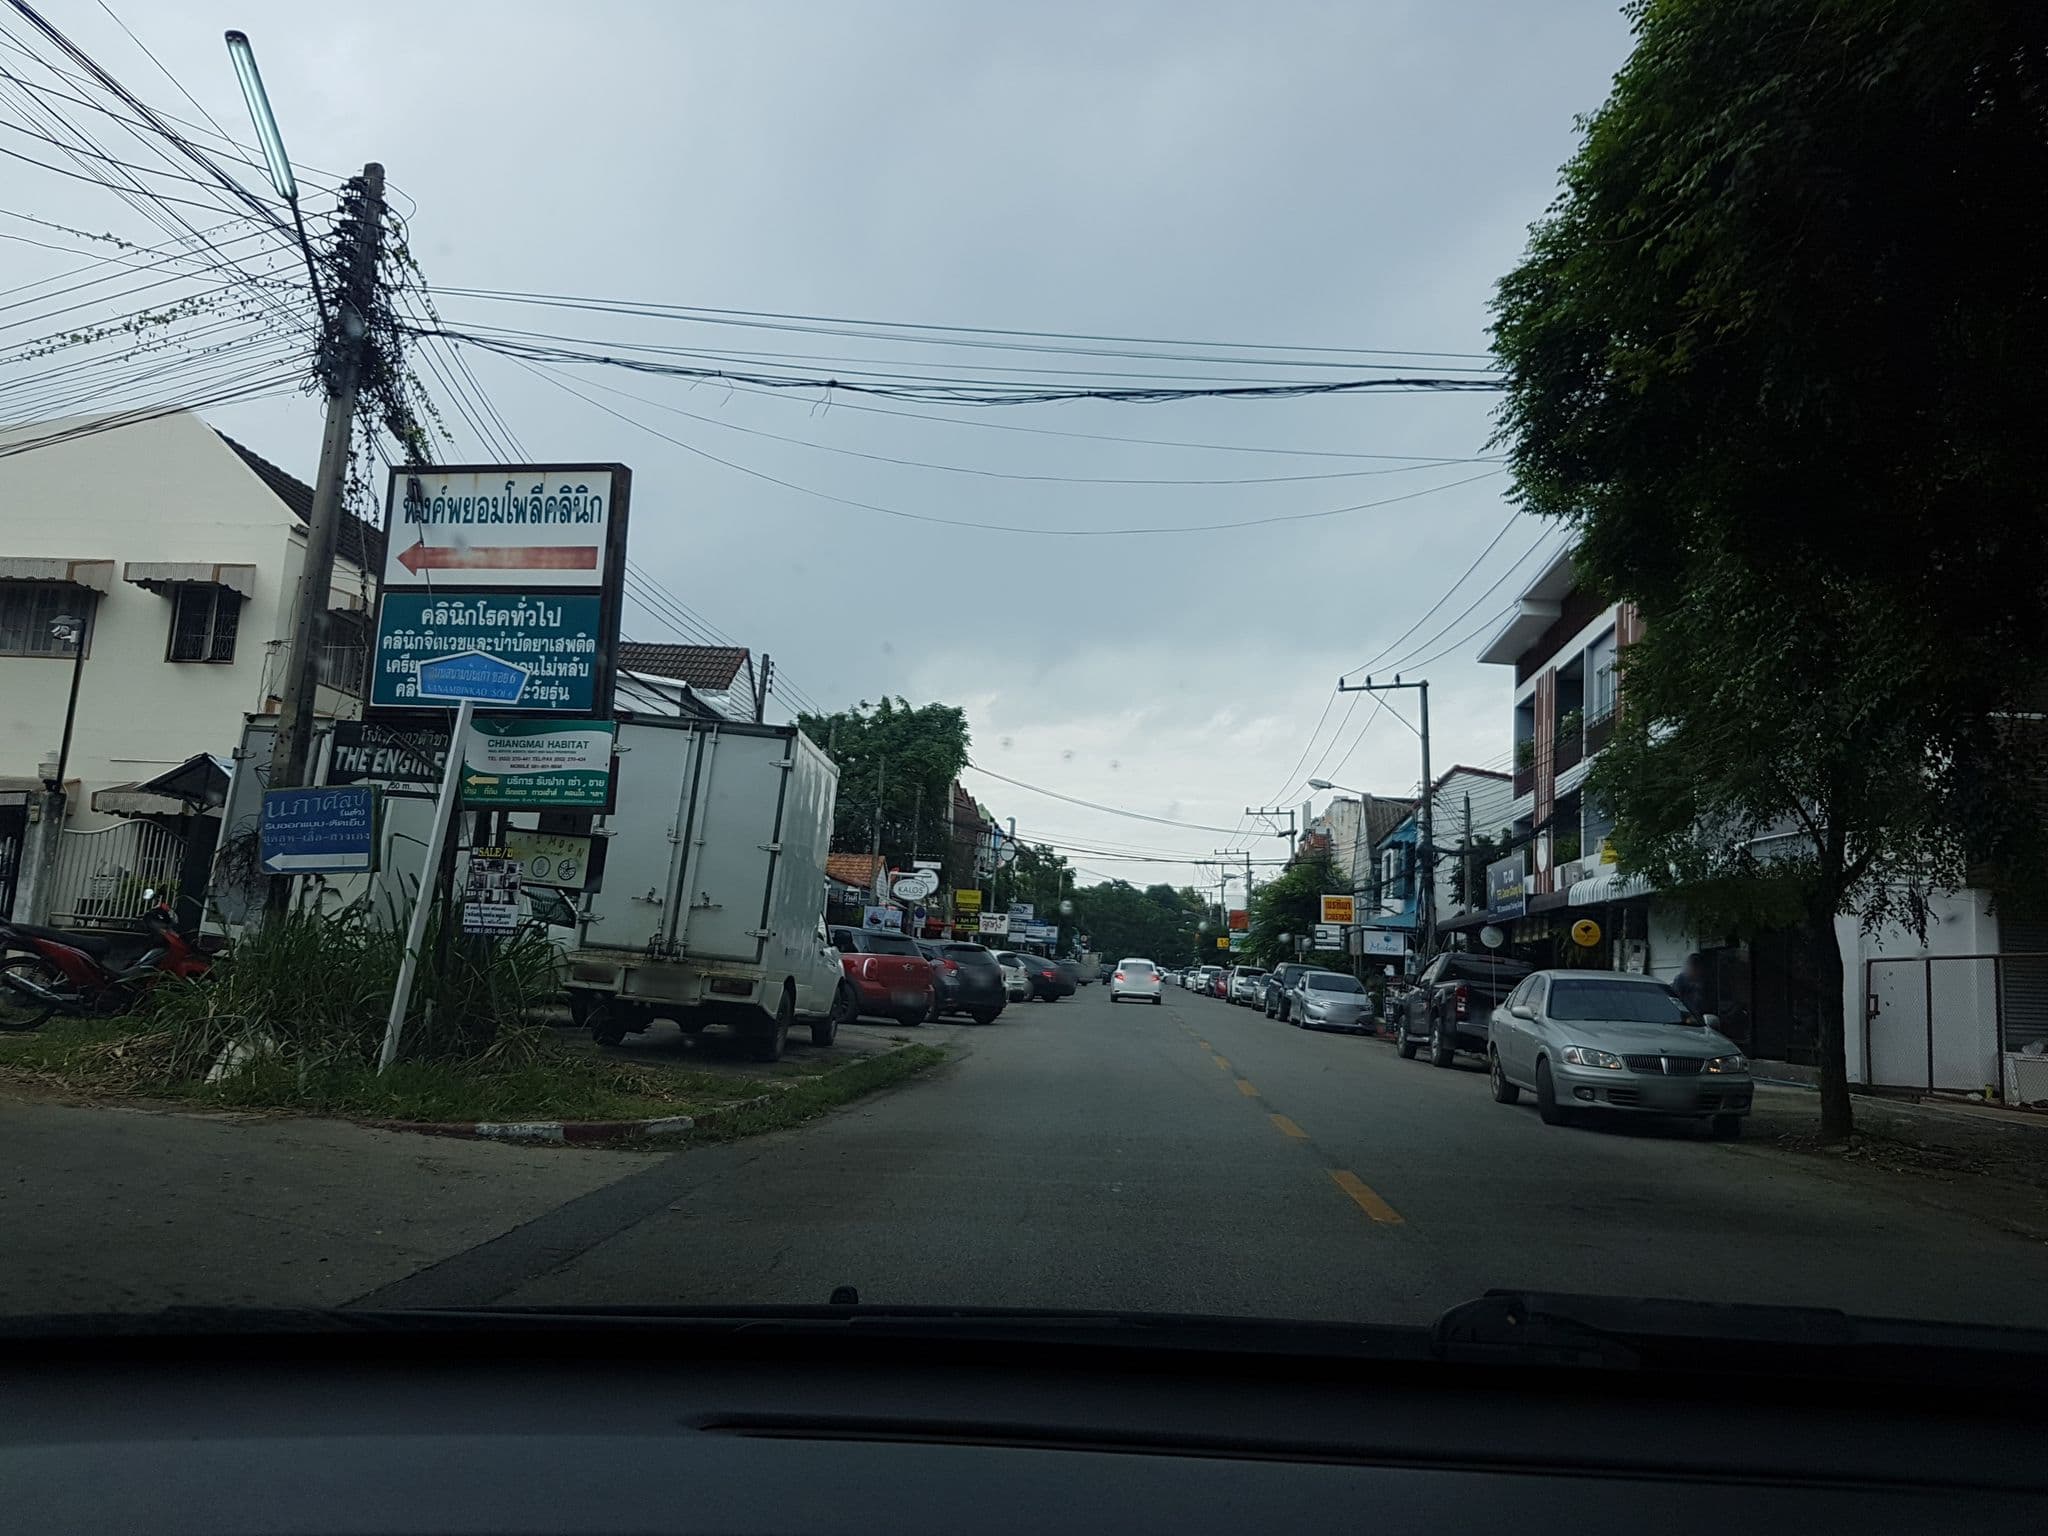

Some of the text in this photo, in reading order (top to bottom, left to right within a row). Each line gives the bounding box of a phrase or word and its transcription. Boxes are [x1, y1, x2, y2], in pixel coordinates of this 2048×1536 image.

[421, 596, 562, 627] คลินิกโรคทั่วไป
[487, 739, 590, 750] CHIANGMAI HABITAT
[335, 746, 446, 777] THE ENGINE
[390, 781, 400, 790] 50
[507, 776, 534, 786] บริการ
[536, 776, 565, 787] รับฝาก
[568, 776, 581, 787] เช่า
[898, 886, 923, 894] KALOS
